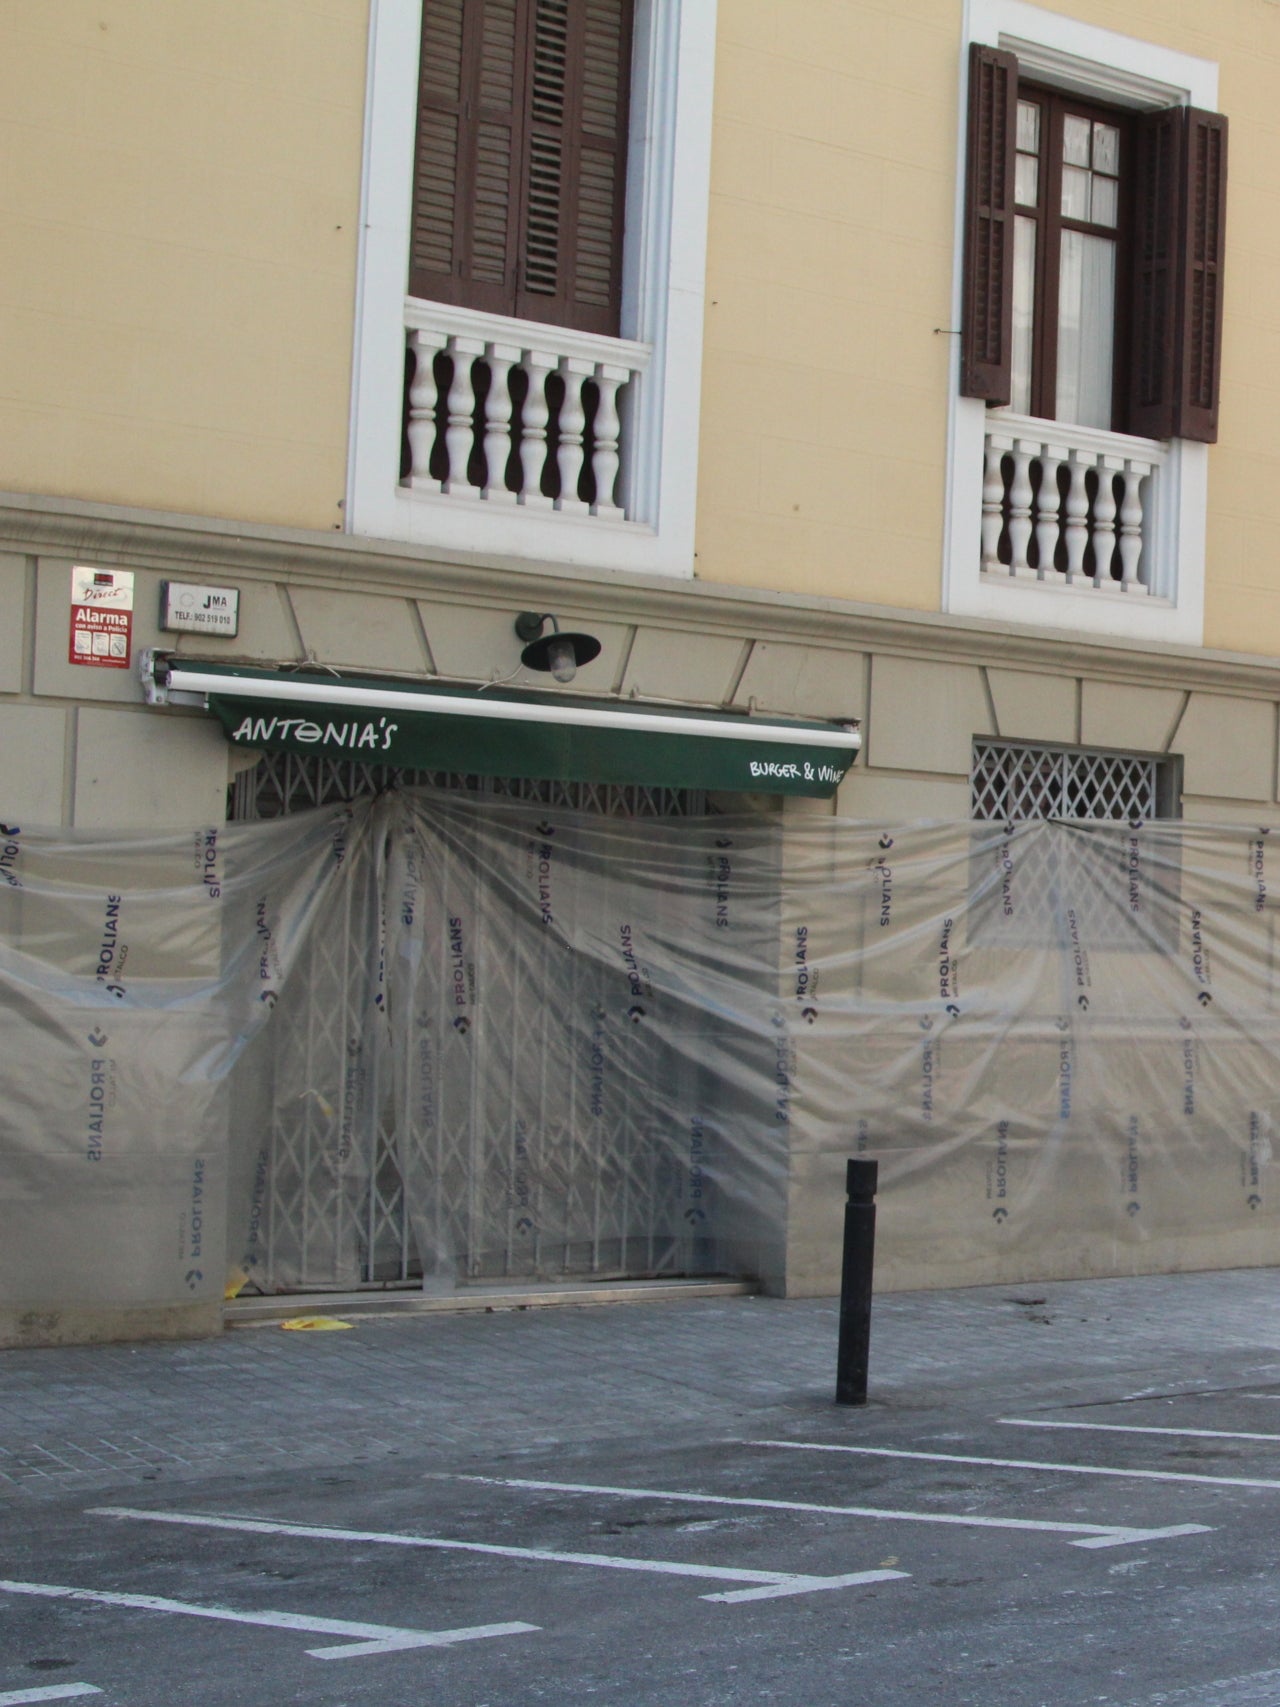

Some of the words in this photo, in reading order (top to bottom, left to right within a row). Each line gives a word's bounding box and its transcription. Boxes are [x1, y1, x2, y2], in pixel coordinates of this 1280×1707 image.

[76, 608, 128, 626] Alarma
[194, 613, 206, 622] 902
[206, 614, 219, 624] 519
[203, 595, 227, 609] JMA
[232, 717, 398, 749] ANTONIA'S
[750, 761, 801, 778] BURGER
[804, 762, 814, 781] &
[1129, 838, 1139, 912] PROLIANS
[1255, 840, 1266, 912] PROLIANS
[450, 917, 465, 1005] PROLIANS
[939, 918, 953, 998] PROLIANS
[1068, 909, 1084, 986] PROLIANS
